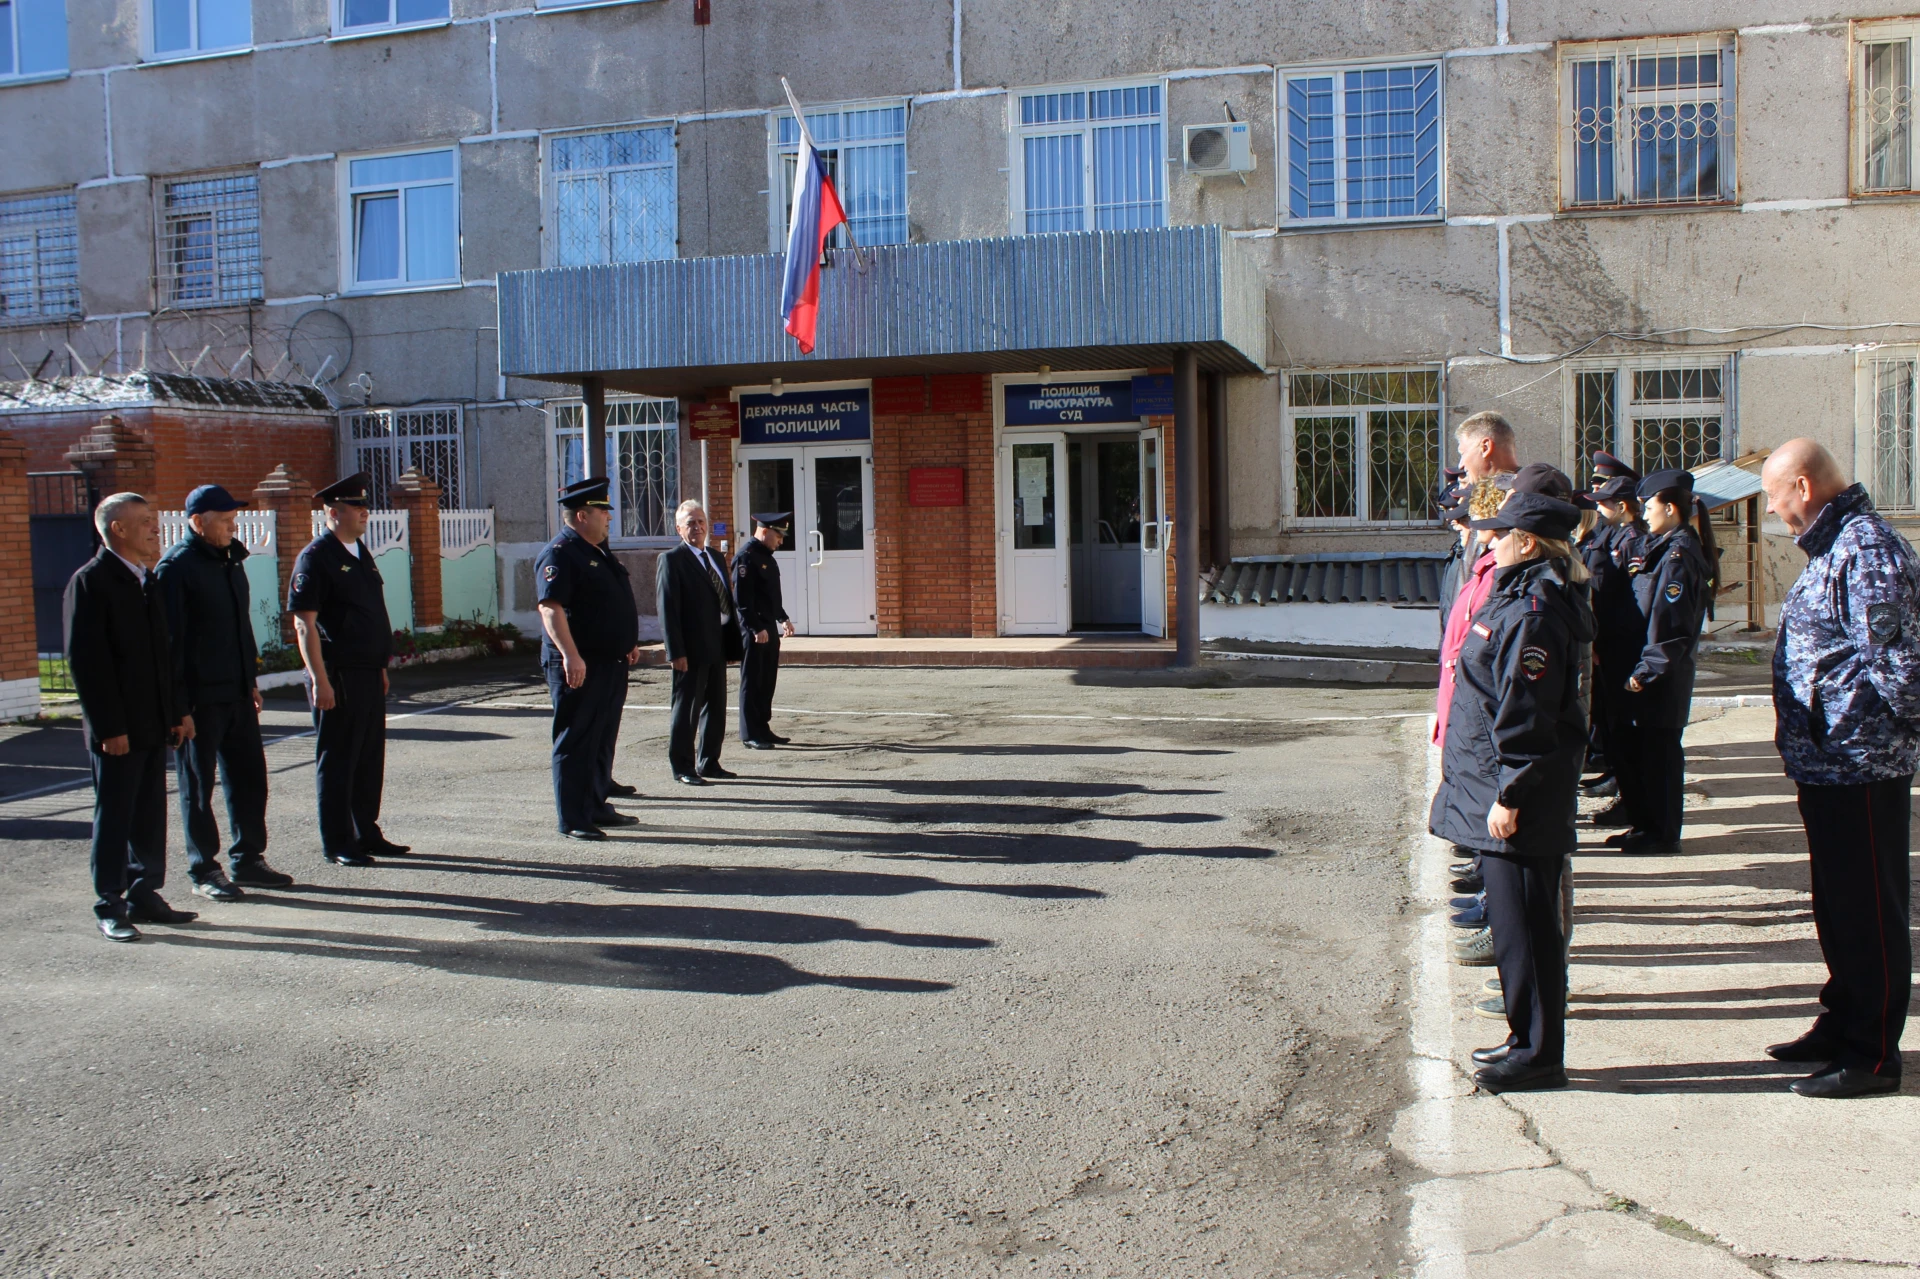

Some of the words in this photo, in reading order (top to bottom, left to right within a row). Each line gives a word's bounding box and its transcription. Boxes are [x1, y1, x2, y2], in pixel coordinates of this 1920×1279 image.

[1040, 385, 1100, 398] ПОЛИЦИЯ
[745, 403, 814, 419] ДЕЖУРНАЯ
[821, 401, 860, 413] ЧАСТЬ
[1029, 397, 1114, 410] ПРОКУРАТУРА
[1059, 410, 1083, 421] СУД
[765, 419, 841, 435] ПОЛИЦИИ
